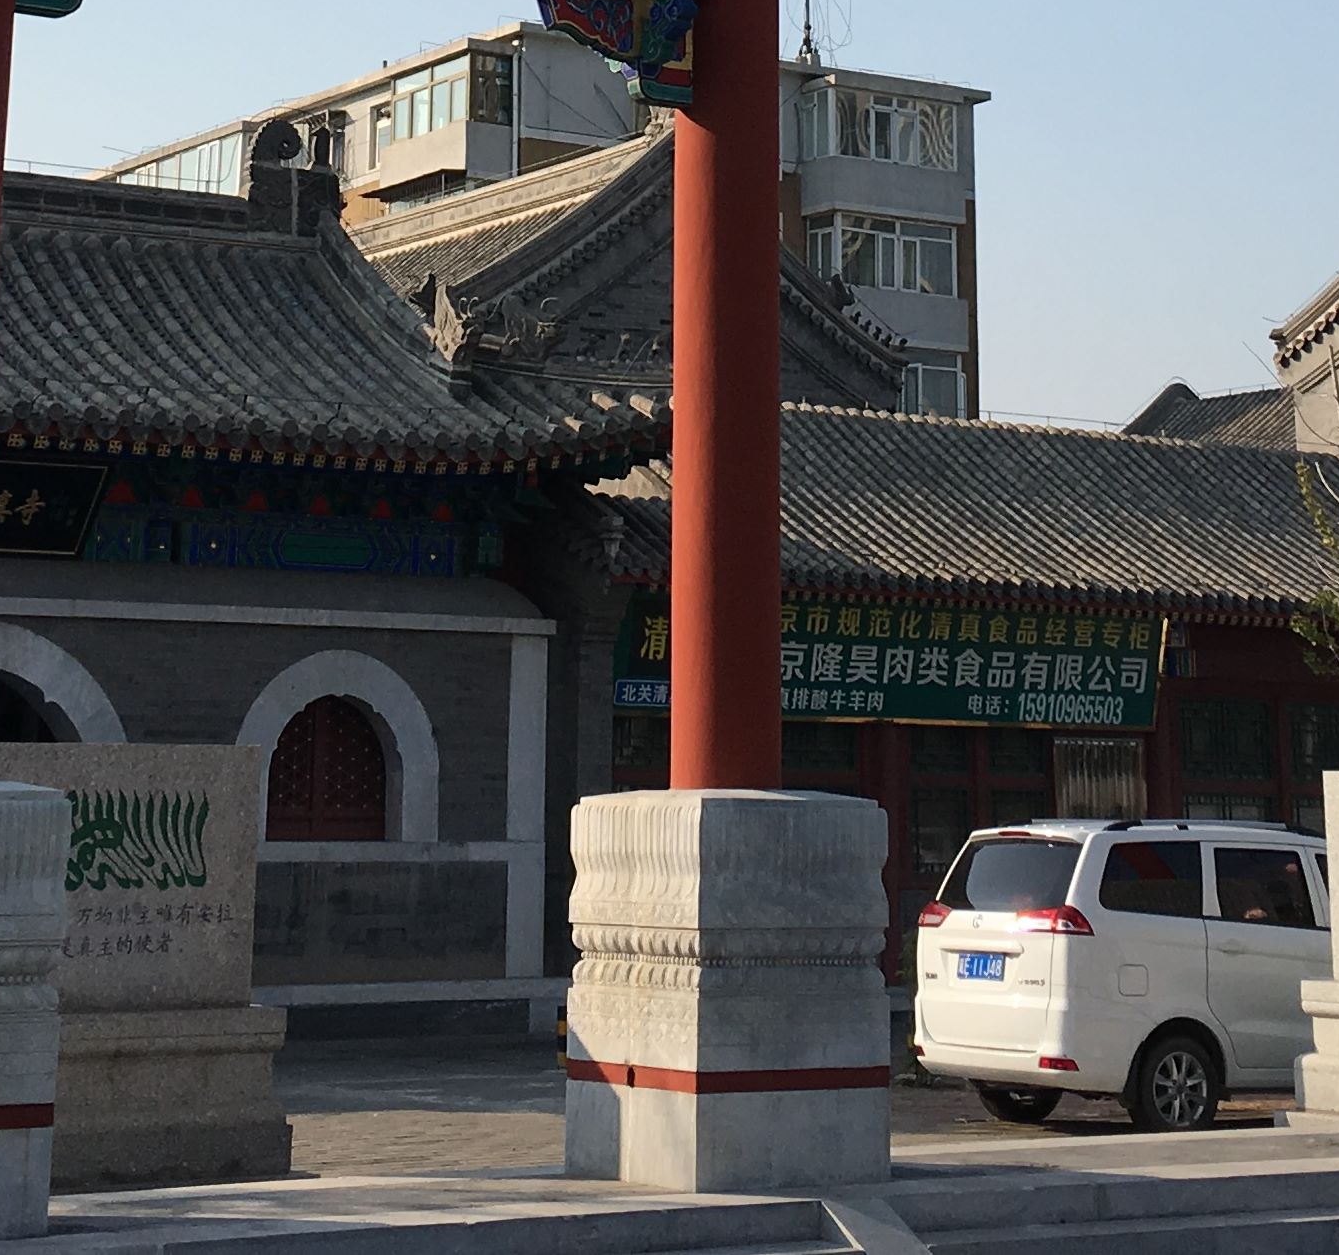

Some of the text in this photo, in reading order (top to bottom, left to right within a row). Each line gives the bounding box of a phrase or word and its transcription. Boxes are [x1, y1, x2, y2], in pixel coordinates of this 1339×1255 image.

[780, 640, 1150, 694] 京隆昊肉类食品有限公司
[1016, 693, 1124, 725] 15910965503
